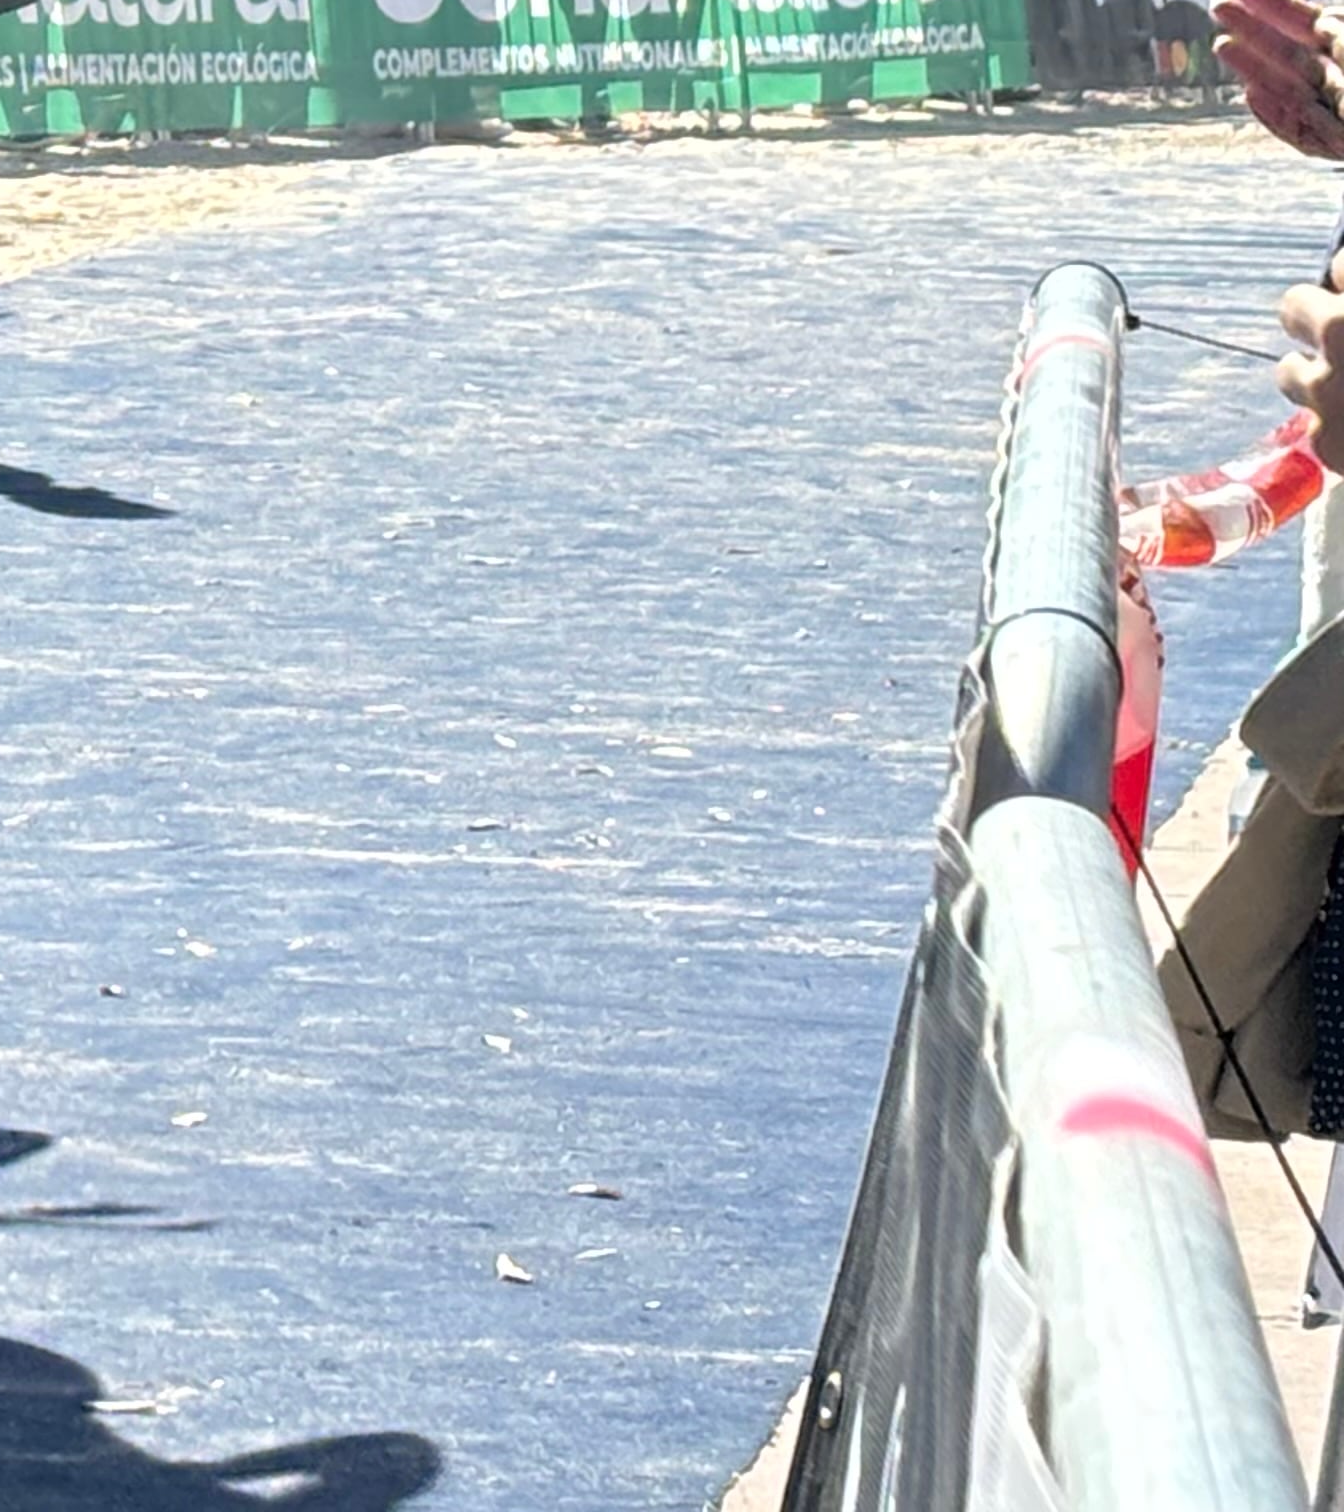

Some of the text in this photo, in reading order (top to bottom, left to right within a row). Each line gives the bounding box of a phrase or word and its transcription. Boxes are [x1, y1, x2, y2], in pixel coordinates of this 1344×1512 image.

[33, 44, 197, 86] ALIMENTACIÓN
[201, 42, 320, 84] ECOLÓGICA
[373, 45, 550, 80] COMPLEMENTOS
